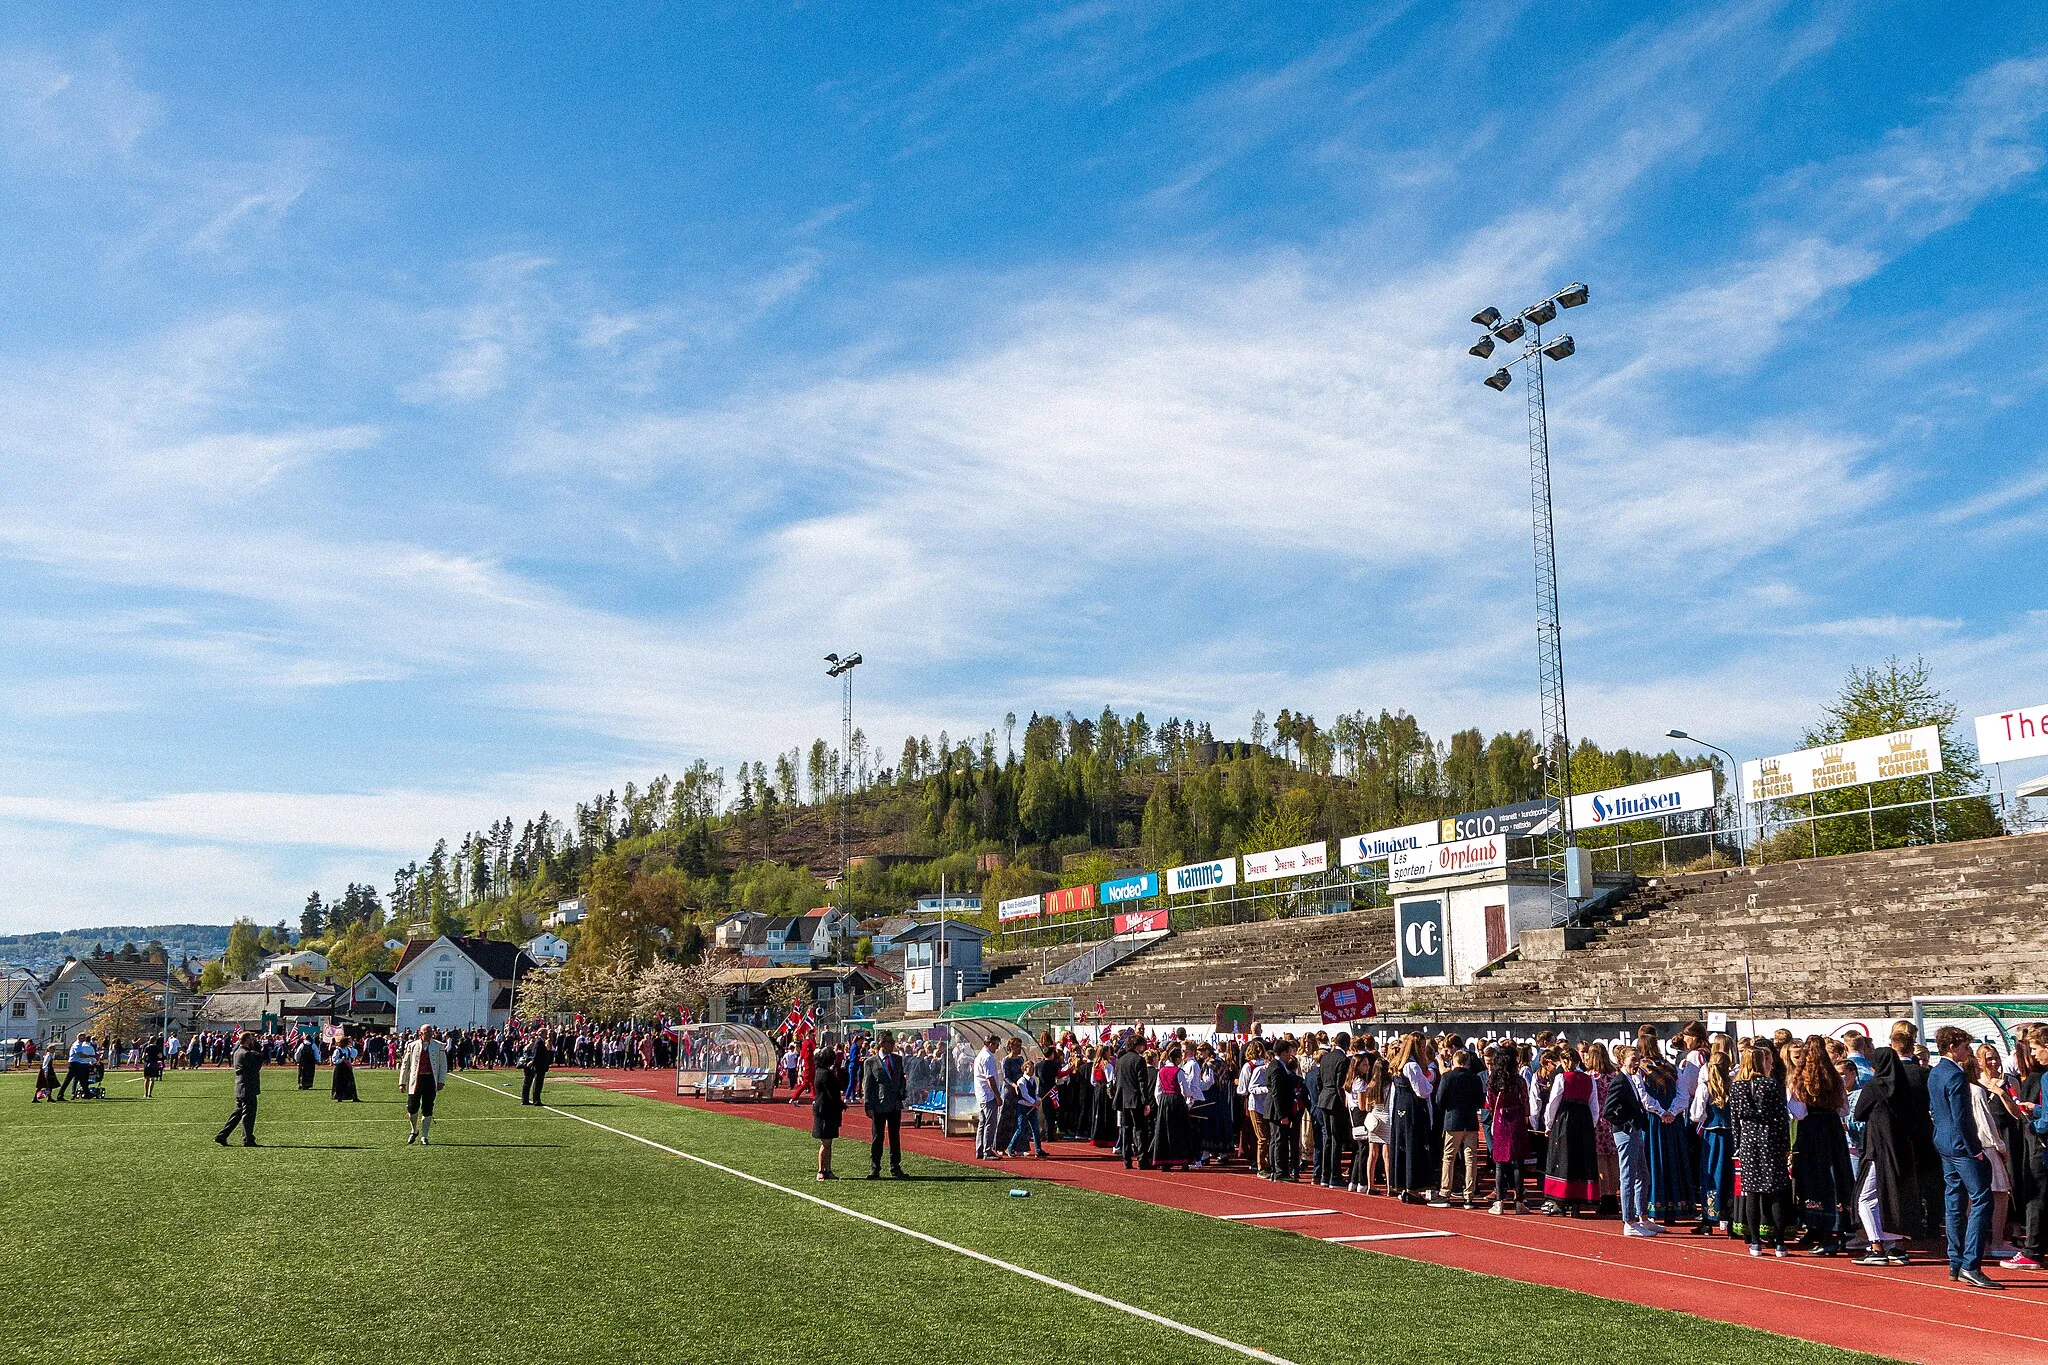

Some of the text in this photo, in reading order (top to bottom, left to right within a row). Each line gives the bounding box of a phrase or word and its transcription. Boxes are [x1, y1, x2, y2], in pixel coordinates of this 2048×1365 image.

[1878, 749, 1928, 765] POLERINGS
[1812, 761, 1857, 776] POLERINGS
[1878, 759, 1929, 778] KONGEN
[1752, 773, 1793, 787] POLERINGS
[1812, 771, 1857, 789] KONGEN
[1753, 783, 1794, 799] KONGEN
[1592, 791, 1681, 822] Syljuåsen
[1394, 852, 1407, 865] Les
[1439, 838, 1497, 871] Oppland
[1394, 861, 1433, 879] sporten i
[1109, 881, 1142, 901] Nordea
[1592, 1030, 1679, 1065] dias
